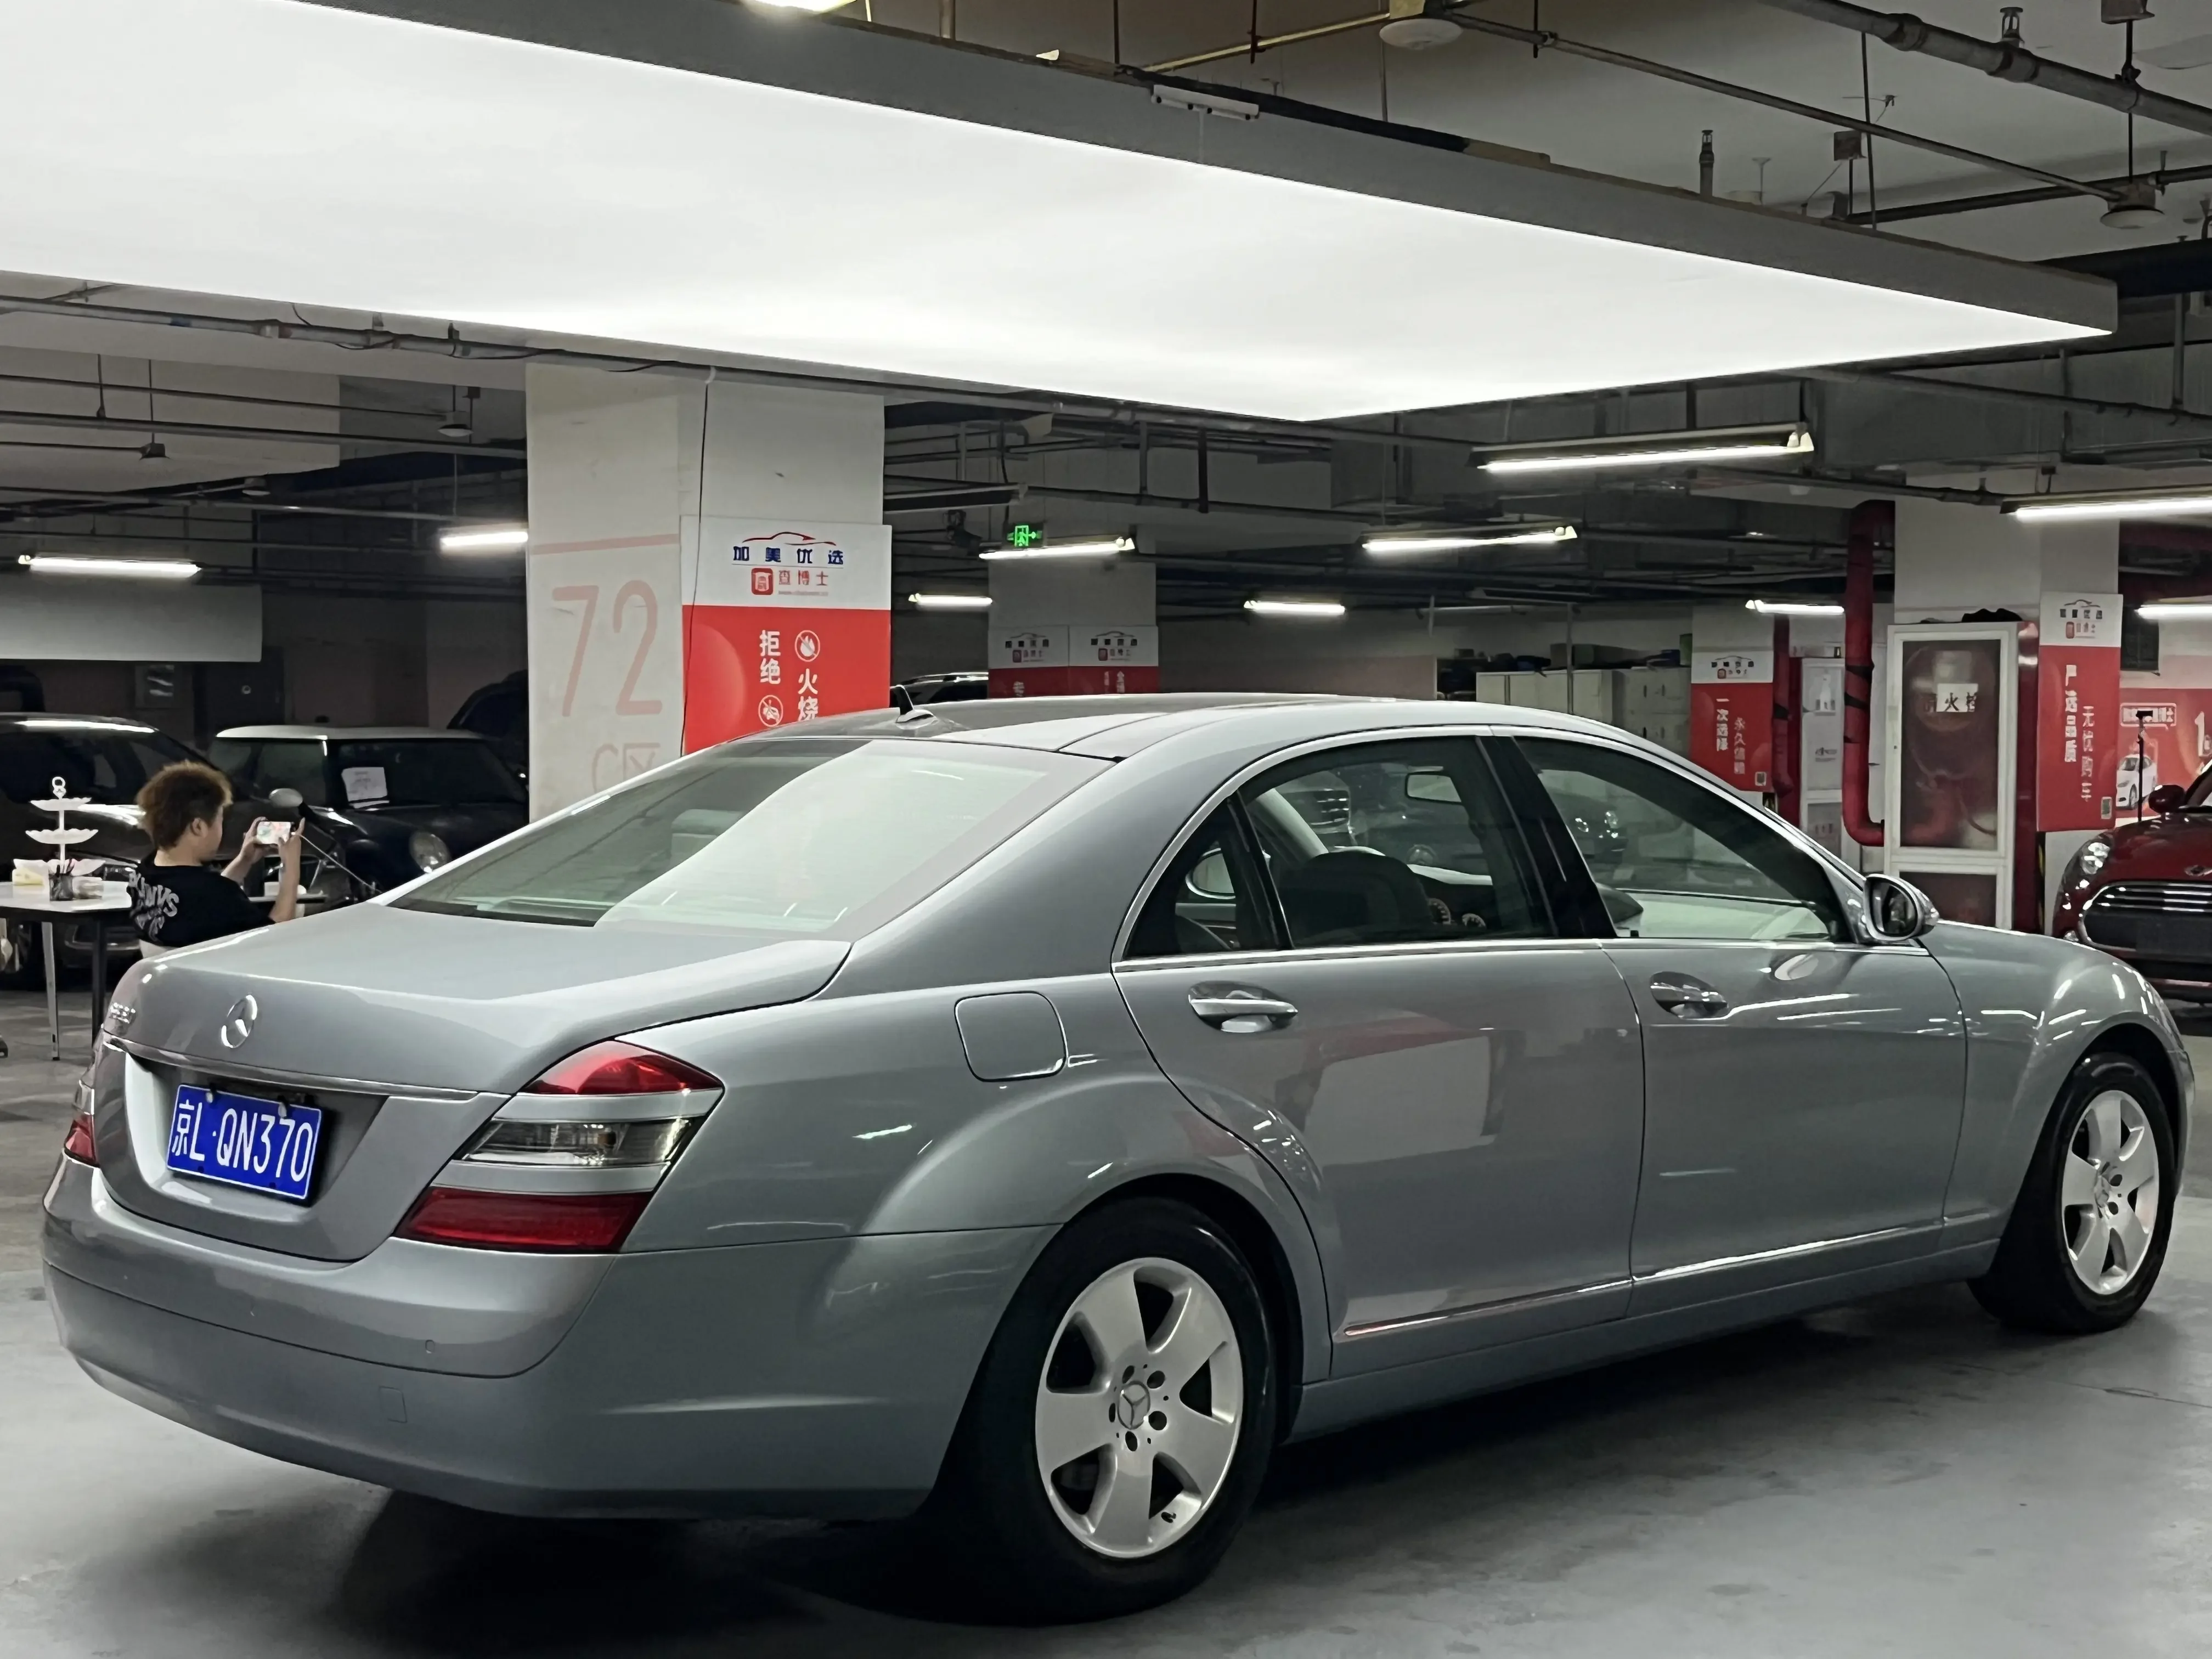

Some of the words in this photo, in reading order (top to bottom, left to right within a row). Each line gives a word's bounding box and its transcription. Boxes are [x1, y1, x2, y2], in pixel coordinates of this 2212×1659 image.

[733, 546, 844, 565] 加美优选
[552, 579, 663, 717] 72
[759, 629, 781, 685] 拒绝
